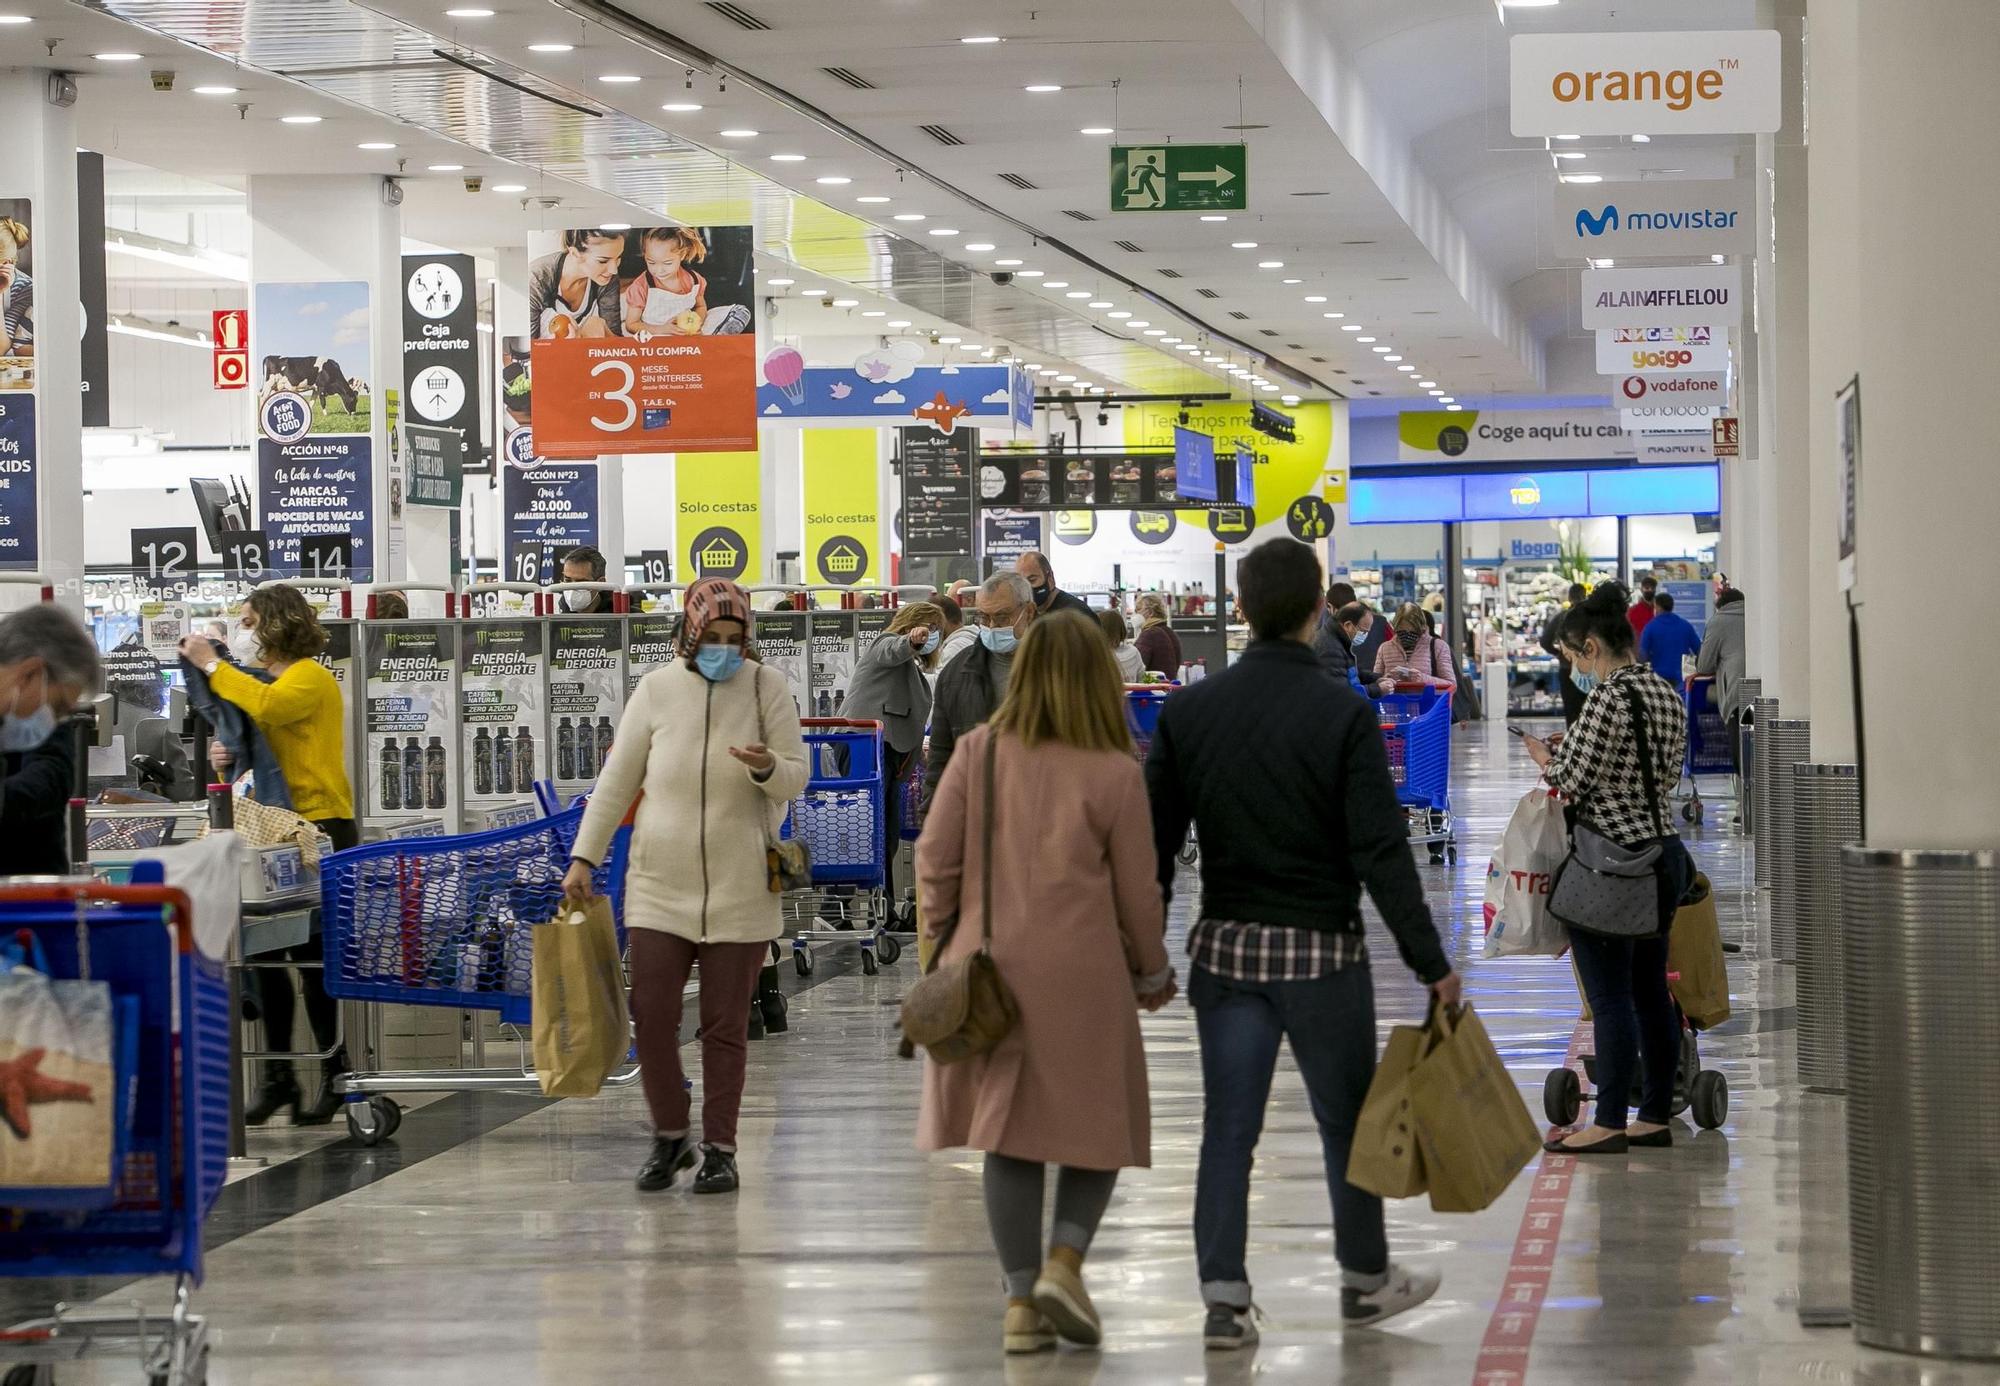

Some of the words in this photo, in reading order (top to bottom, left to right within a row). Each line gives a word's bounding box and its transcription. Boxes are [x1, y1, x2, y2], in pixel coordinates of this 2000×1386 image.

[1552, 67, 1722, 112] orange
[1627, 209, 1738, 229] movistar
[1596, 291, 1651, 307] ALAIN
[1645, 289, 1728, 306] AFFLELOU
[422, 324, 450, 338] Caja
[404, 338, 470, 352] preferente
[588, 348, 638, 358] FINANCIA
[640, 347, 653, 356] TU
[656, 346, 702, 357] COMPRA
[1632, 350, 1692, 368] yoigo
[641, 365, 669, 374] MESES
[641, 375, 656, 383] SIN
[657, 374, 702, 382] INTERESES
[1651, 378, 1718, 392] vodafone
[589, 391, 601, 399] EN
[590, 360, 637, 432] 3
[642, 398, 664, 406] T.A.E.
[277, 411, 295, 424] FOR
[276, 419, 301, 433] FOOD
[1478, 424, 1524, 442] Coge
[1529, 422, 1568, 442] aquí
[1574, 424, 1592, 438] tu
[281, 444, 322, 456] ACCIÓN
[323, 444, 349, 455] Nº48
[522, 469, 556, 480] ACCIÓN
[556, 471, 579, 480] Nº23
[290, 486, 338, 497] MARCAS
[279, 497, 348, 507] CARREFOUR
[530, 500, 572, 511] 30.000
[679, 501, 709, 513] Solo
[712, 501, 757, 513] cestas
[267, 512, 315, 522] PROCEDE
[316, 511, 330, 521] DE
[331, 511, 365, 521] VACAS
[556, 511, 589, 519] CALIDAD
[807, 513, 834, 524] Solo
[836, 513, 876, 524] cestas
[281, 522, 351, 534] AUTÓCTONAS
[536, 520, 548, 536] al
[141, 541, 188, 579] 12
[230, 543, 263, 578] 13
[283, 551, 300, 562] EN
[308, 546, 346, 578] 14
[515, 552, 537, 581] 16
[645, 559, 665, 583] 19
[757, 636, 794, 648] NERGÍA
[472, 650, 526, 665] ENERGÍA
[555, 645, 606, 659] ENERGÍA
[638, 653, 673, 663] DEPOR
[760, 647, 802, 657] DEPORTE
[379, 654, 438, 670] ENERGÍA
[565, 659, 615, 669] DEPORTE
[482, 664, 536, 675] DEPORTE
[390, 670, 449, 682] DEPORTE
